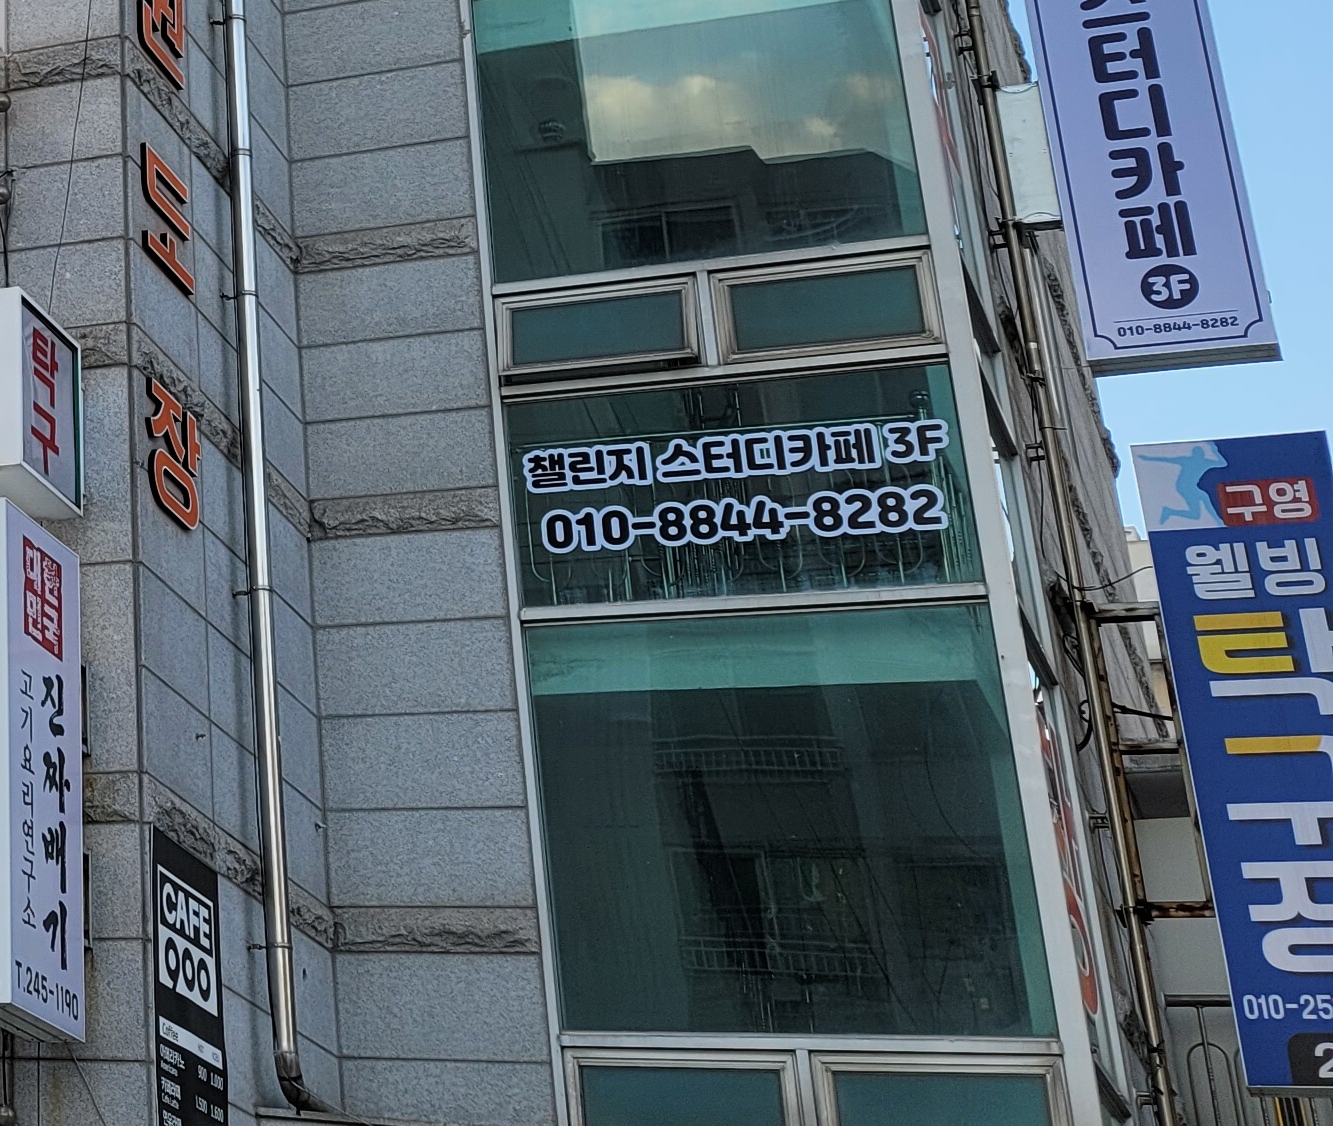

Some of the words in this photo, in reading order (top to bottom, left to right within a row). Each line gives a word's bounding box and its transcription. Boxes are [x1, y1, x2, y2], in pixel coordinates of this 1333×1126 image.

[1146, 272, 1192, 304] 3F
[1116, 315, 1240, 338] 010-8844-8282
[30, 325, 60, 476] 탁구
[526, 443, 649, 491] 챌린지
[658, 427, 878, 479] 스터디카페
[885, 423, 945, 460] 3F
[545, 488, 943, 551] 010-8844-8282
[1225, 479, 1313, 522] 구영
[1184, 537, 1326, 601] 웰빙
[19, 668, 37, 930] 고기요리연구소
[40, 673, 71, 971] 진짜배기
[162, 882, 211, 952] CAFE
[14, 959, 80, 1023] T.245-1190
[164, 936, 211, 1003] 900
[1242, 993, 1333, 1021] 010-25
